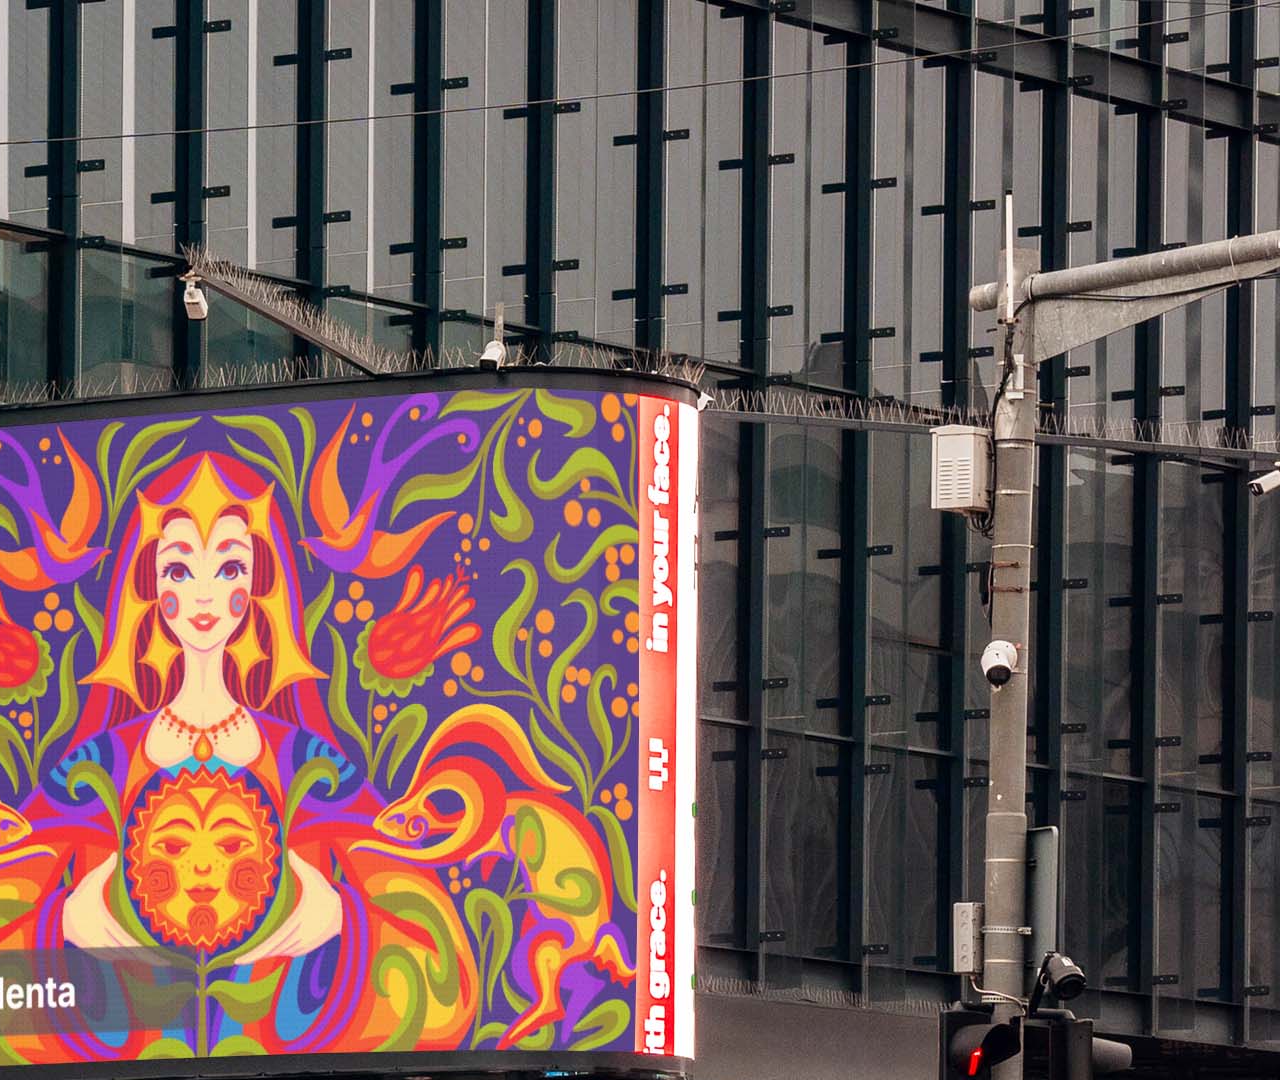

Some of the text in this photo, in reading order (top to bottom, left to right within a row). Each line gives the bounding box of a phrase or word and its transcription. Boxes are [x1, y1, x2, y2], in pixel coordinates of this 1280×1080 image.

[646, 404, 673, 653] in your face.
[649, 869, 671, 1000] grace.
